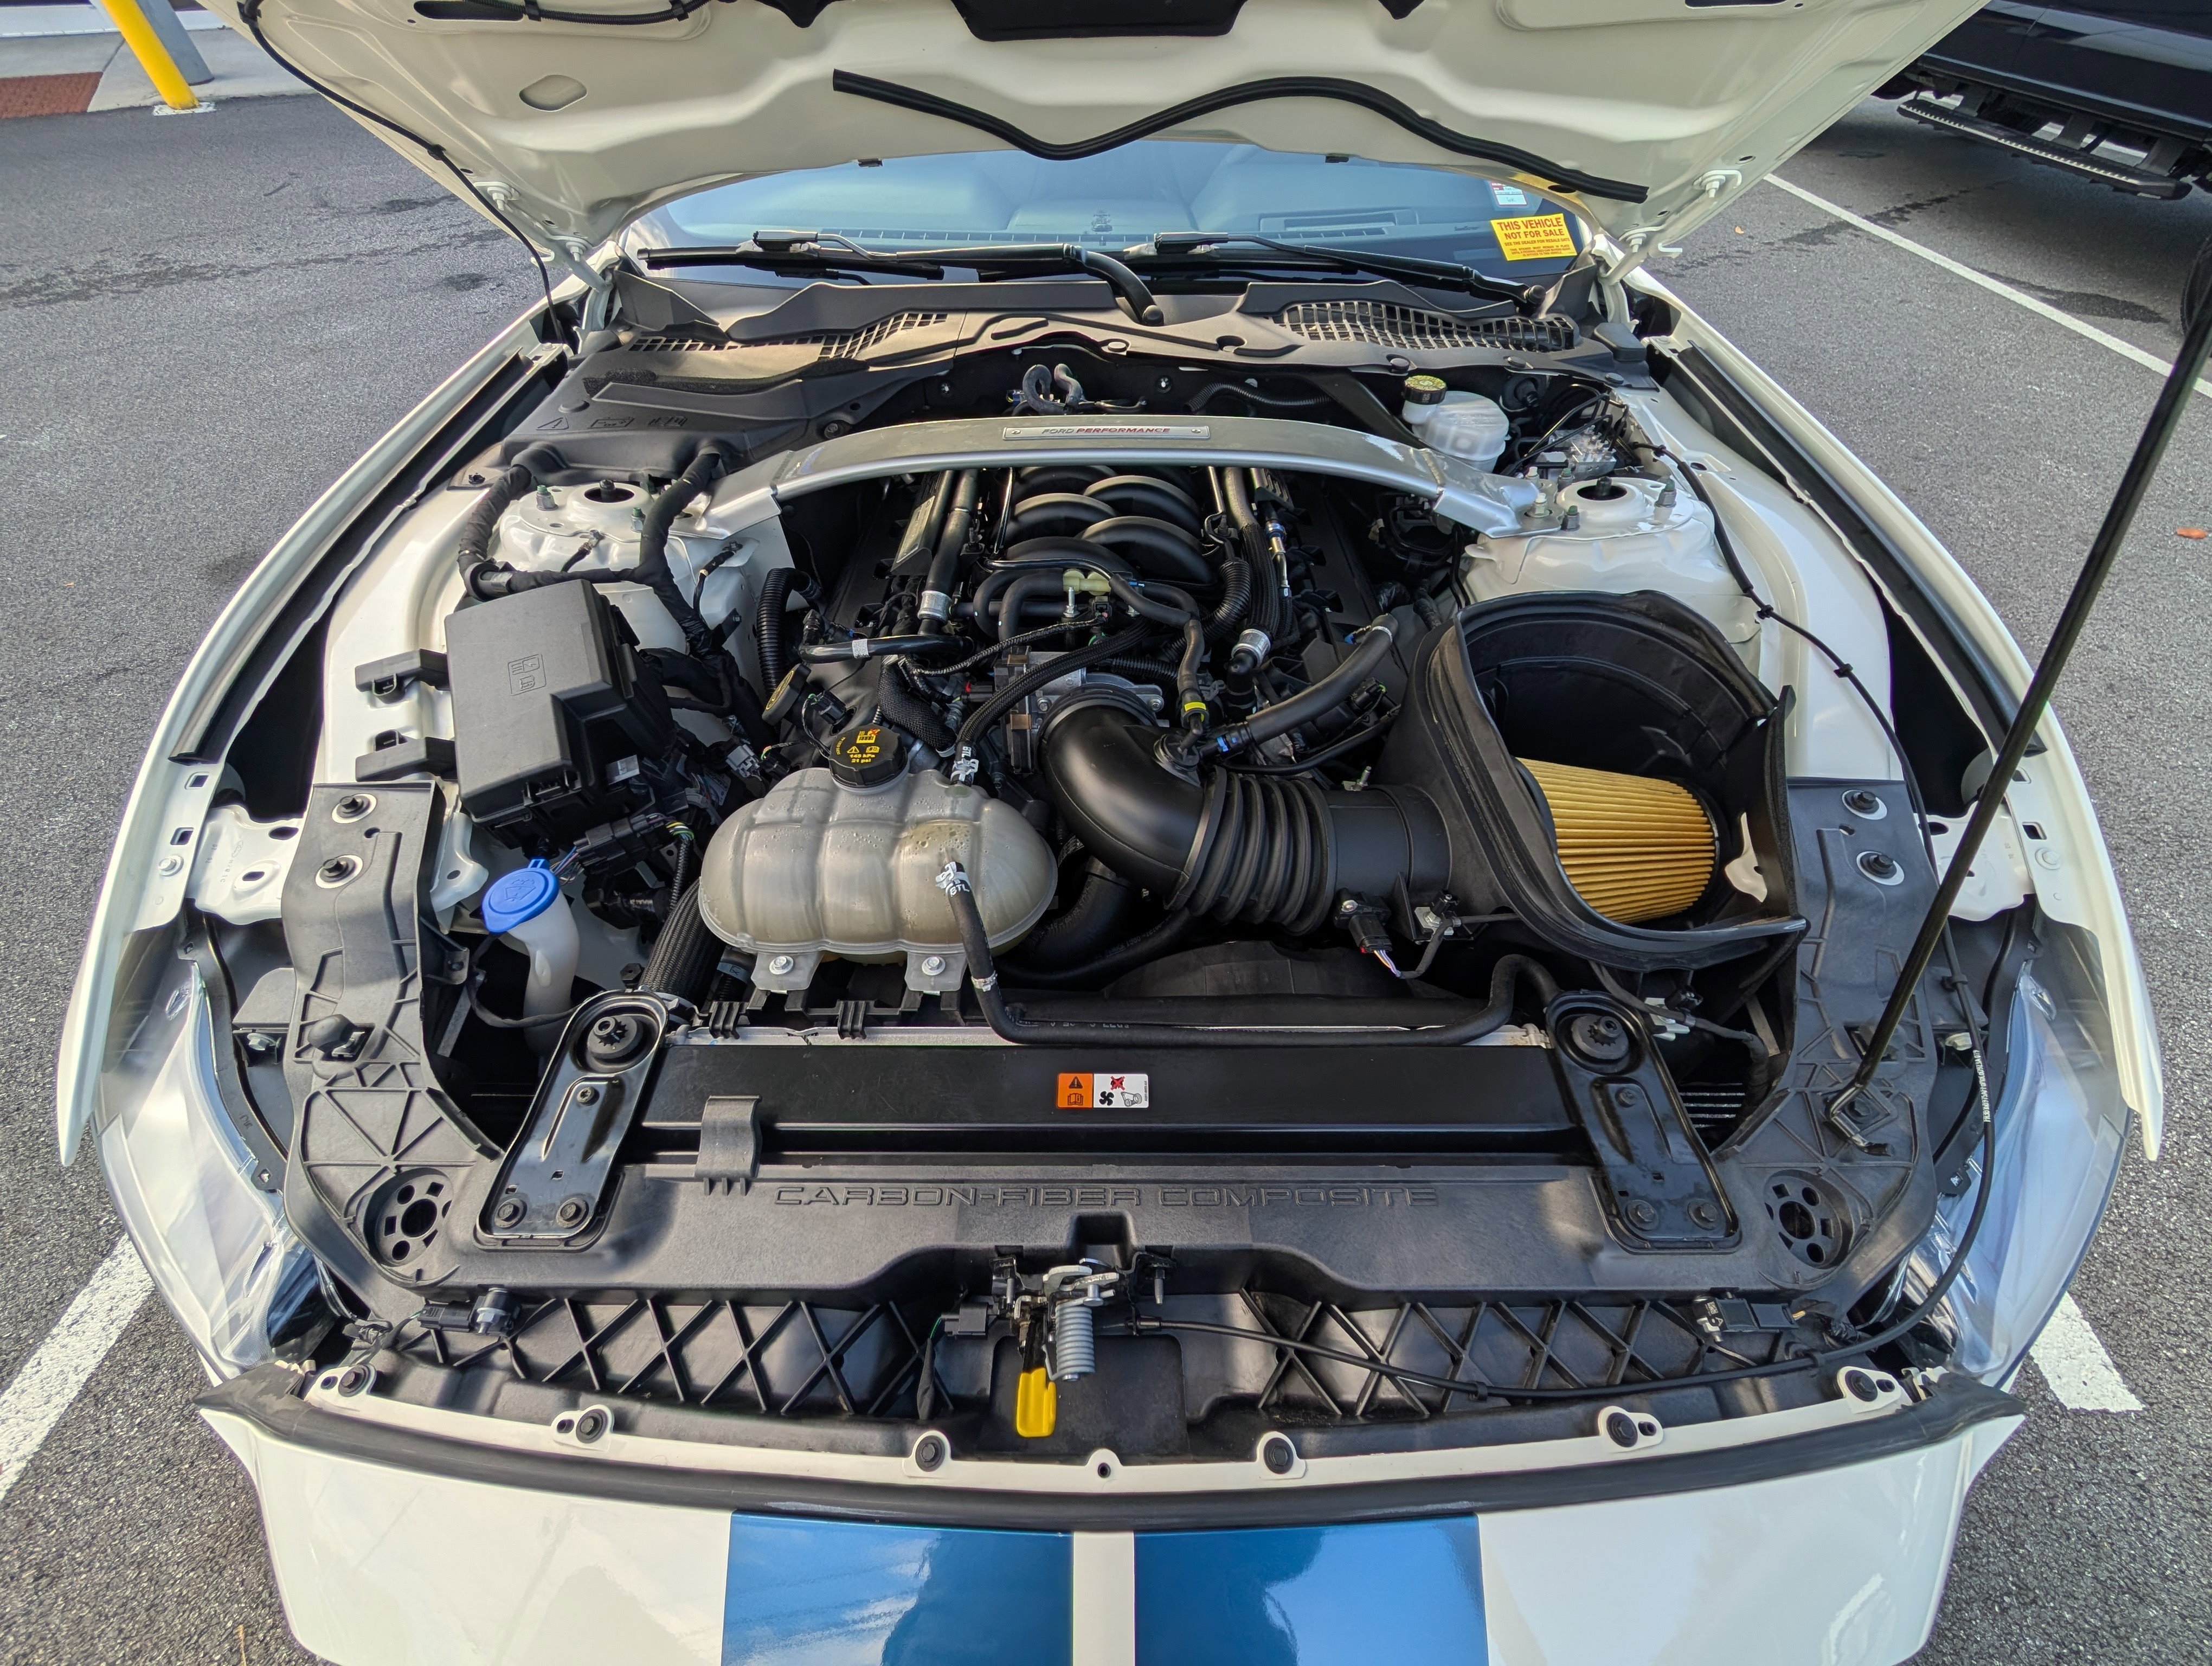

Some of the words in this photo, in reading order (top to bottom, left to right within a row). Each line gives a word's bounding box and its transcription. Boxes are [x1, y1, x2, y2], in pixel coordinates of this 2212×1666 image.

[1497, 221, 1521, 231] THIS
[1521, 217, 1563, 229] VEHICLE
[1504, 232, 1521, 240] NOT
[950, 884, 969, 898] BTL
[774, 1186, 1141, 1206] CARBON-FIBER
[1158, 1187, 1438, 1207] COMPOSITE
